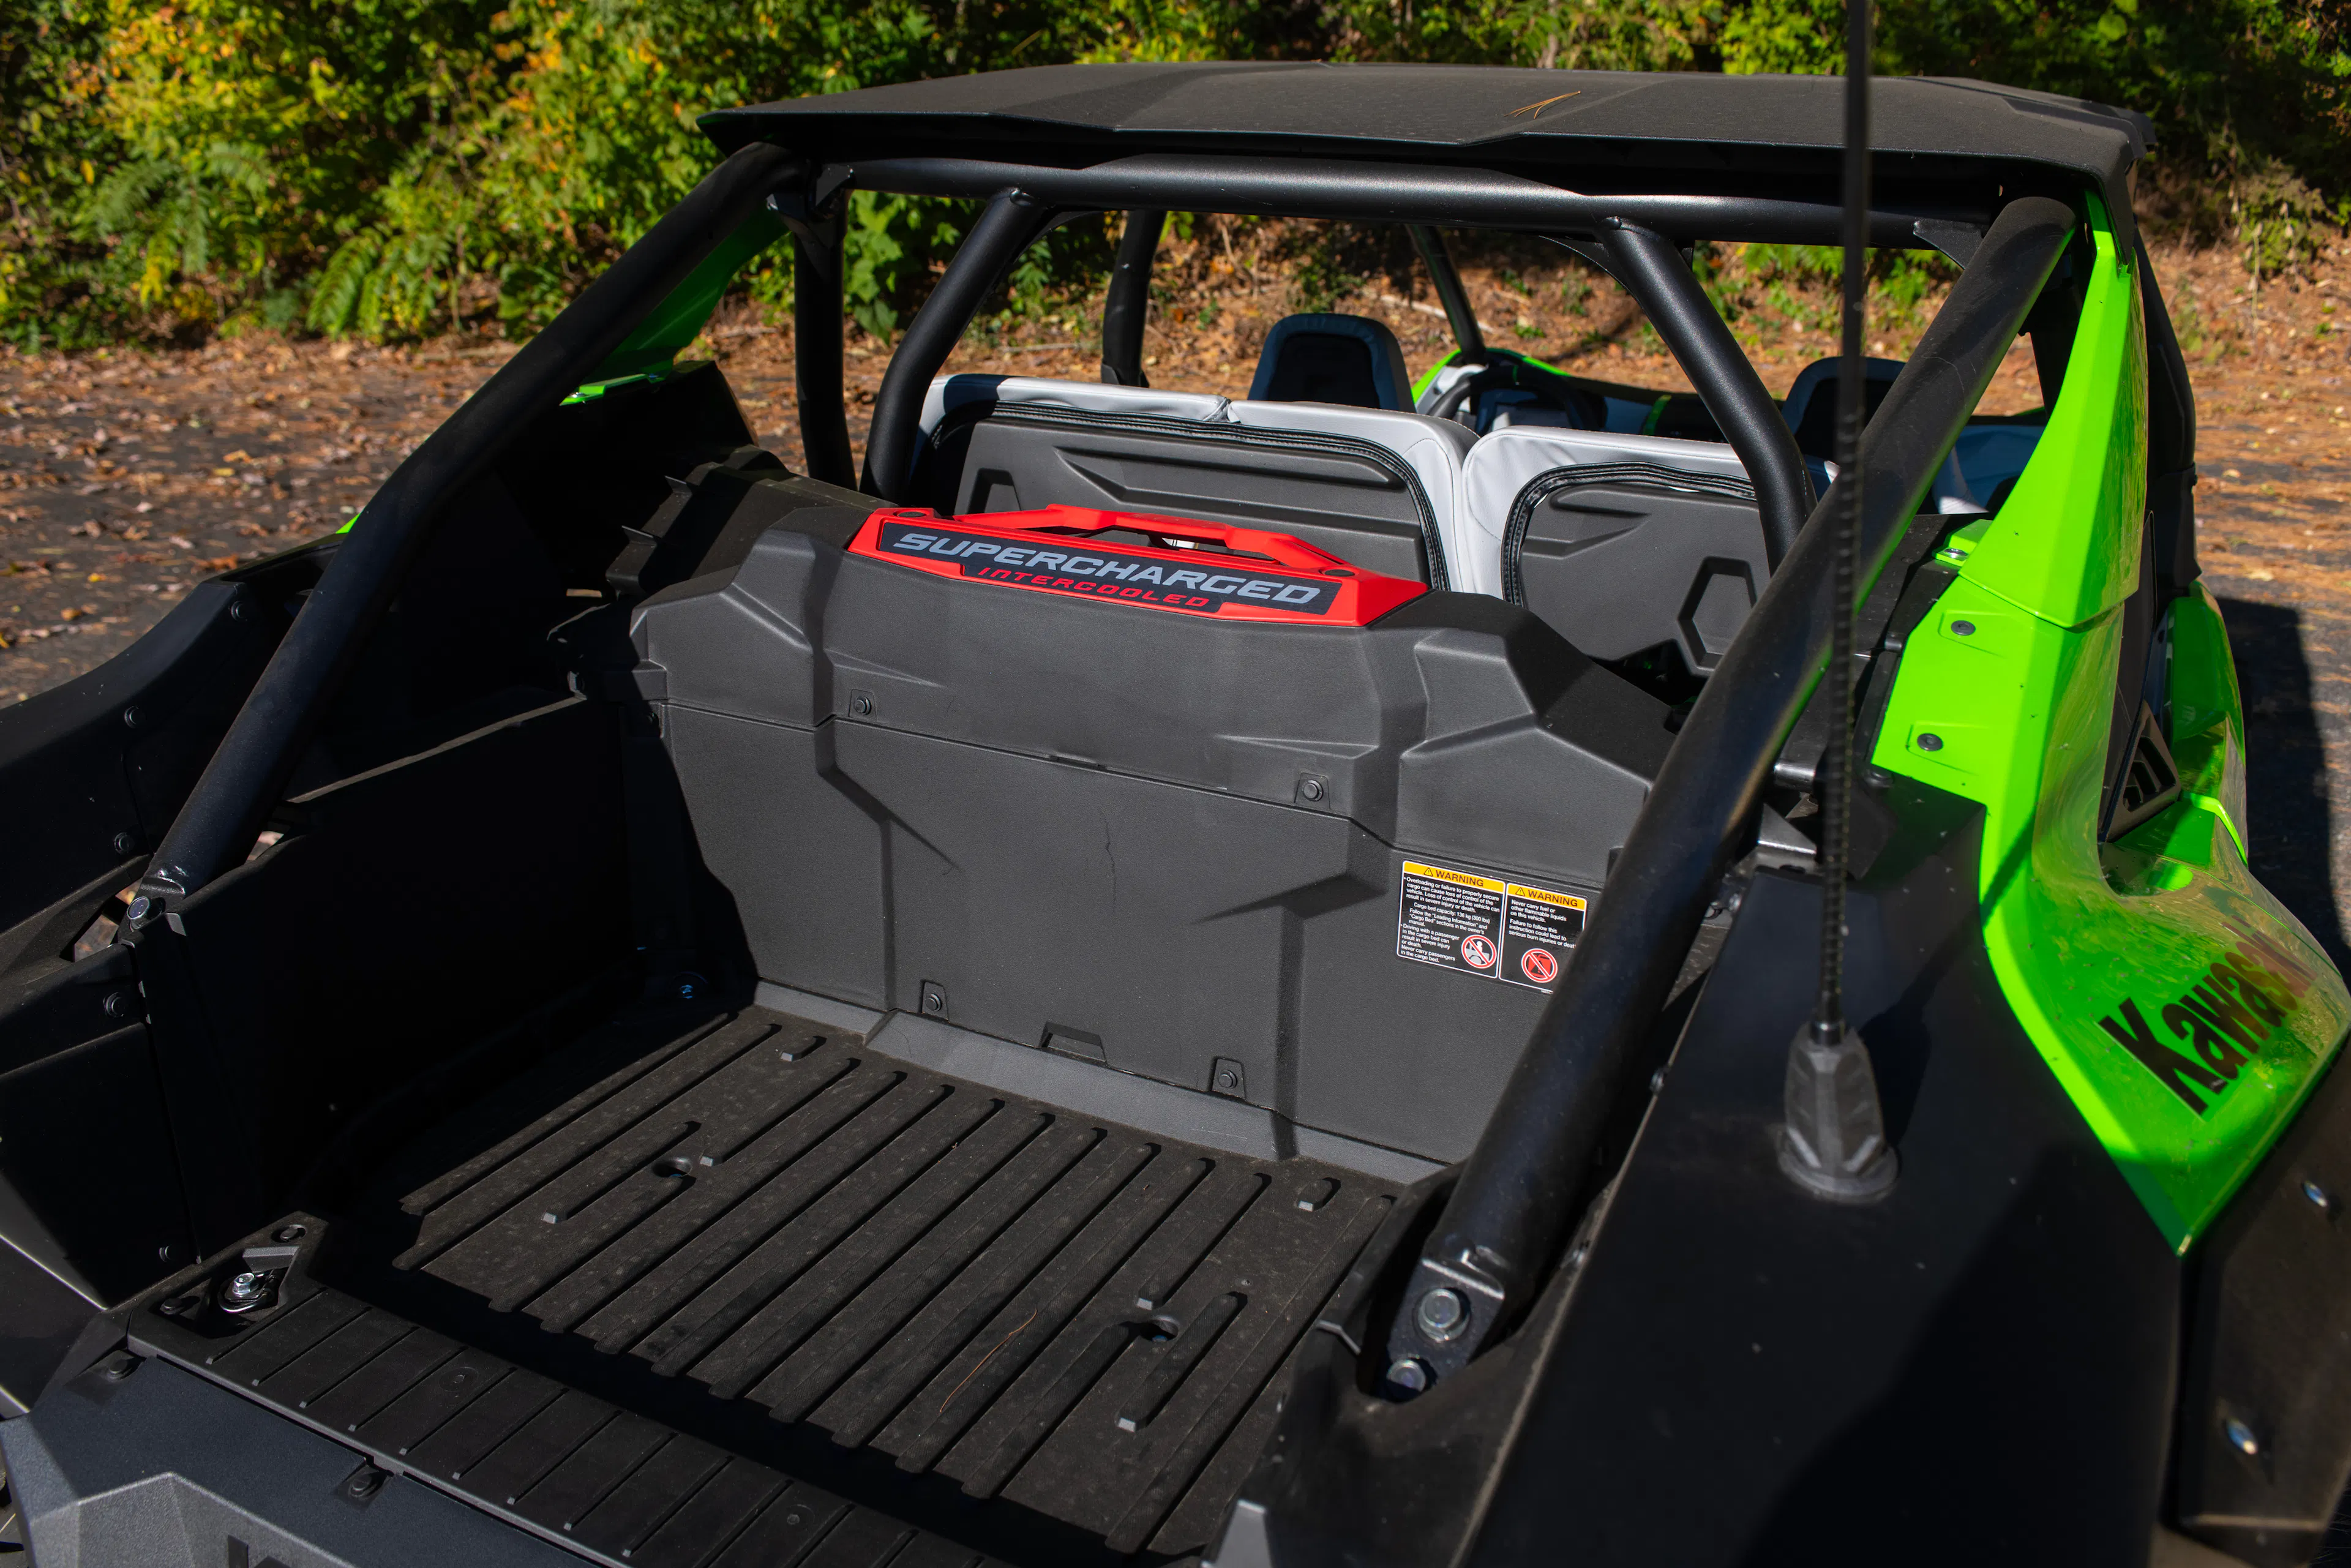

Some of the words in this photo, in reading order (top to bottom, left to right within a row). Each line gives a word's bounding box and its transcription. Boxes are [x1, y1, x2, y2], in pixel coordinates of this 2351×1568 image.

[893, 533, 1321, 604] SUPERCHARGED
[978, 567, 1210, 607] INTERCOOLED
[1436, 869, 1483, 887] WARNING
[1406, 876, 1434, 888] Overloading
[1462, 889, 1482, 898] properly
[1441, 900, 1455, 909] injury
[1528, 890, 1578, 907] WARNING
[1436, 907, 1456, 916] capacity:
[1524, 907, 1550, 917] flammable
[1550, 913, 1567, 921] liquids
[1509, 923, 1534, 934] instruction
[1510, 918, 1526, 926] Failure
[1403, 923, 1419, 932] Driving
[1434, 931, 1460, 940] passenger
[1437, 941, 1450, 950] injury
[1539, 936, 1556, 944] injuries
[1428, 951, 1455, 961] passengers
[2098, 915, 2318, 1115] Kawasaki
